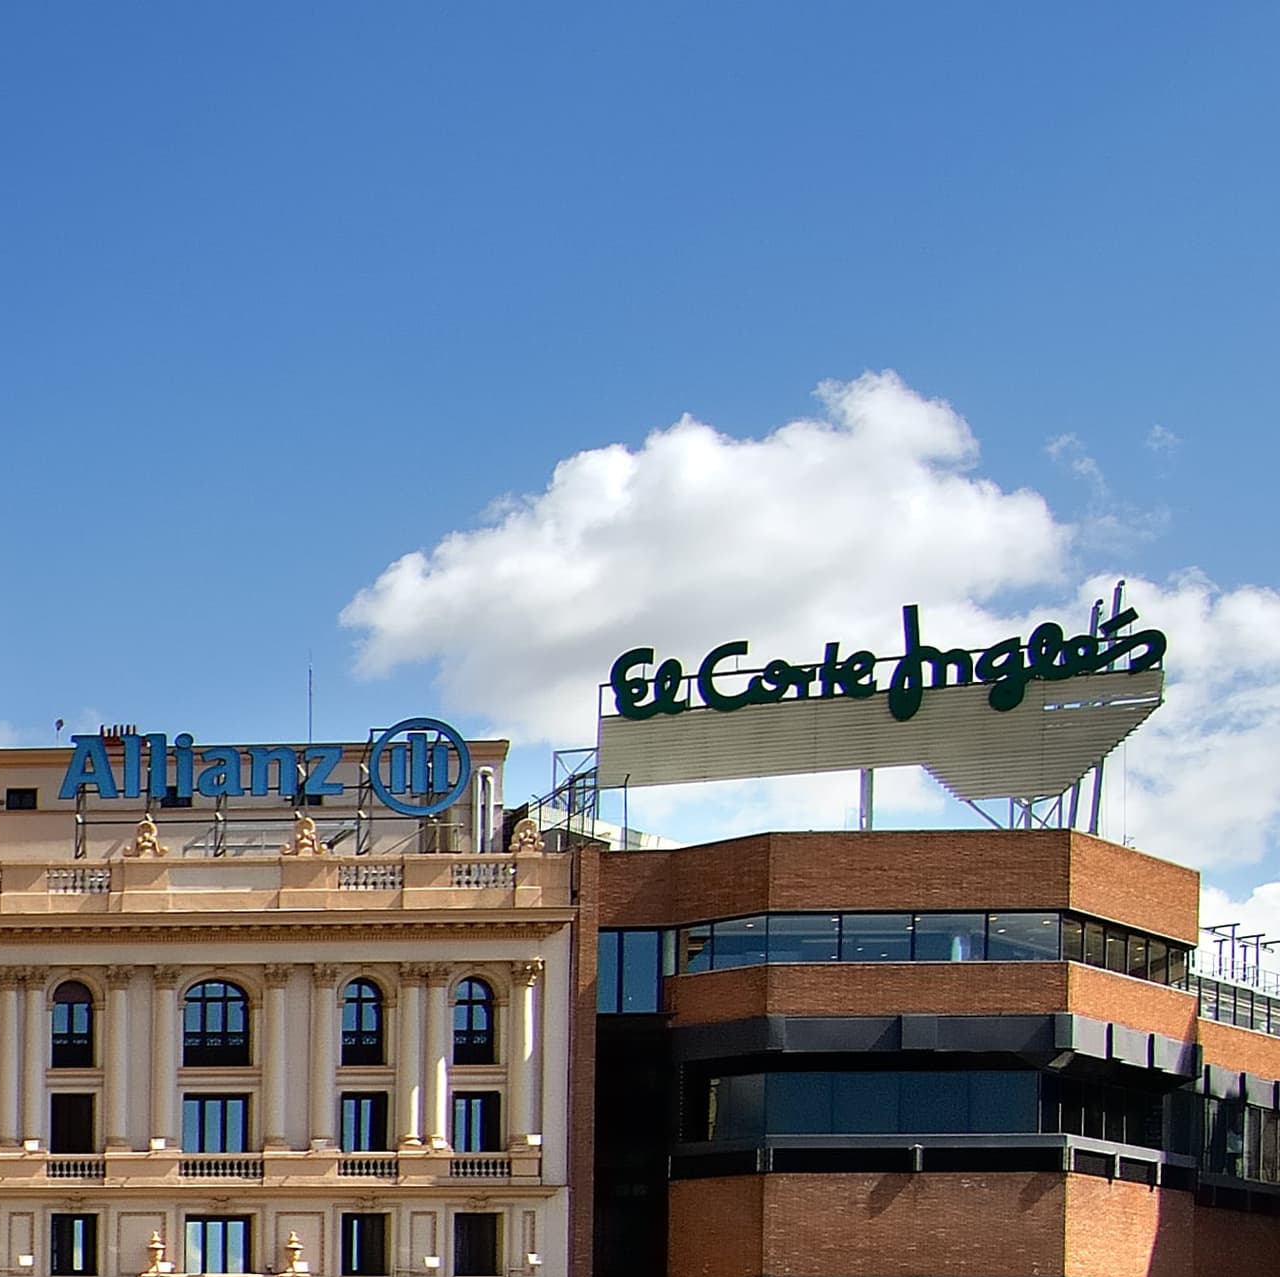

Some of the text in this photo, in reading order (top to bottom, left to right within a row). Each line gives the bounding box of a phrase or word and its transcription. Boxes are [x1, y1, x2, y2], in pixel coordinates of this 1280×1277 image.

[611, 605, 1167, 721] El Corte Inglés
[58, 733, 344, 799] Allianz
